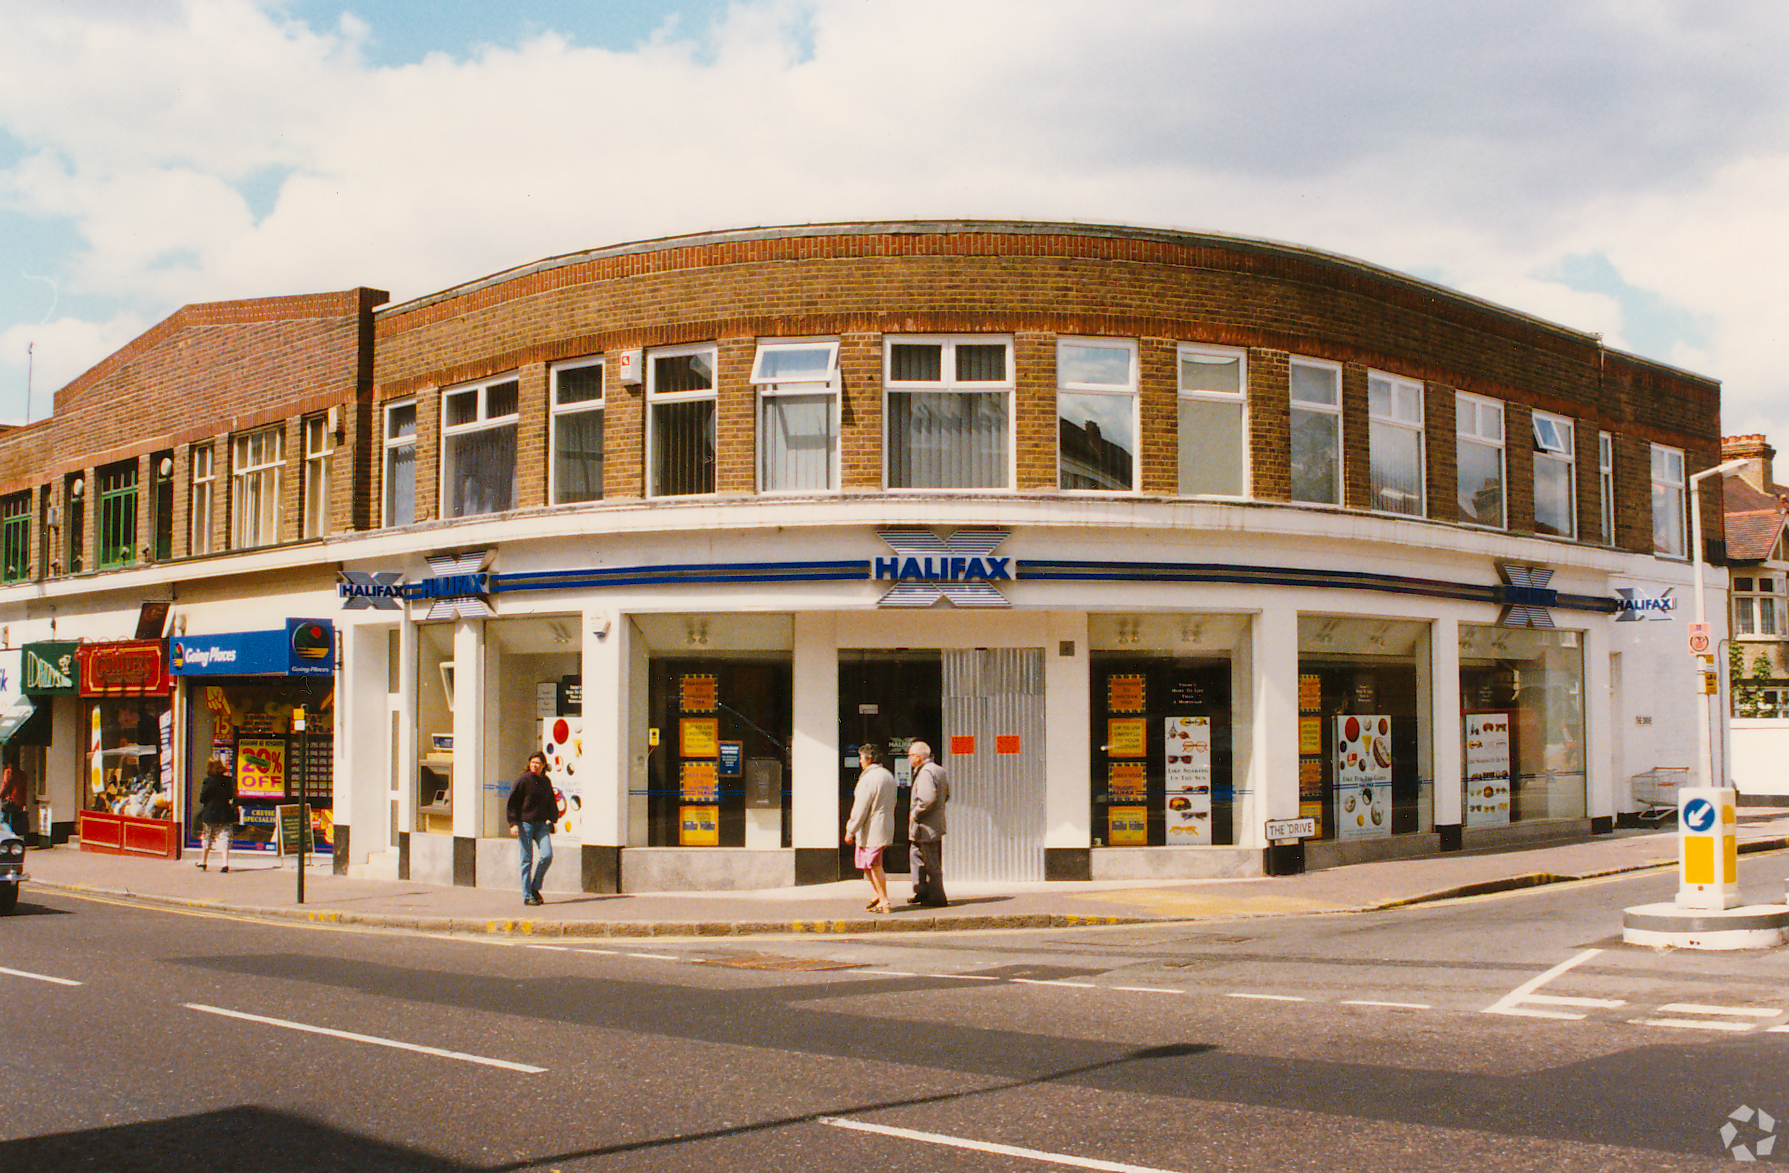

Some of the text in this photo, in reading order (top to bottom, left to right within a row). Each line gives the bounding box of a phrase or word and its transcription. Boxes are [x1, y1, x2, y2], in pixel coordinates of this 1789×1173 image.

[875, 556, 1011, 580] HALIFAX
[342, 585, 405, 598] HALIFAX
[422, 573, 488, 600] HALIFAX
[1617, 598, 1672, 611] HALIFAX
[185, 646, 237, 668] Going Places
[291, 665, 310, 674] Going
[241, 747, 283, 774] 20%
[241, 775, 282, 788] OFF
[1269, 822, 1312, 836] THE DRIVE
